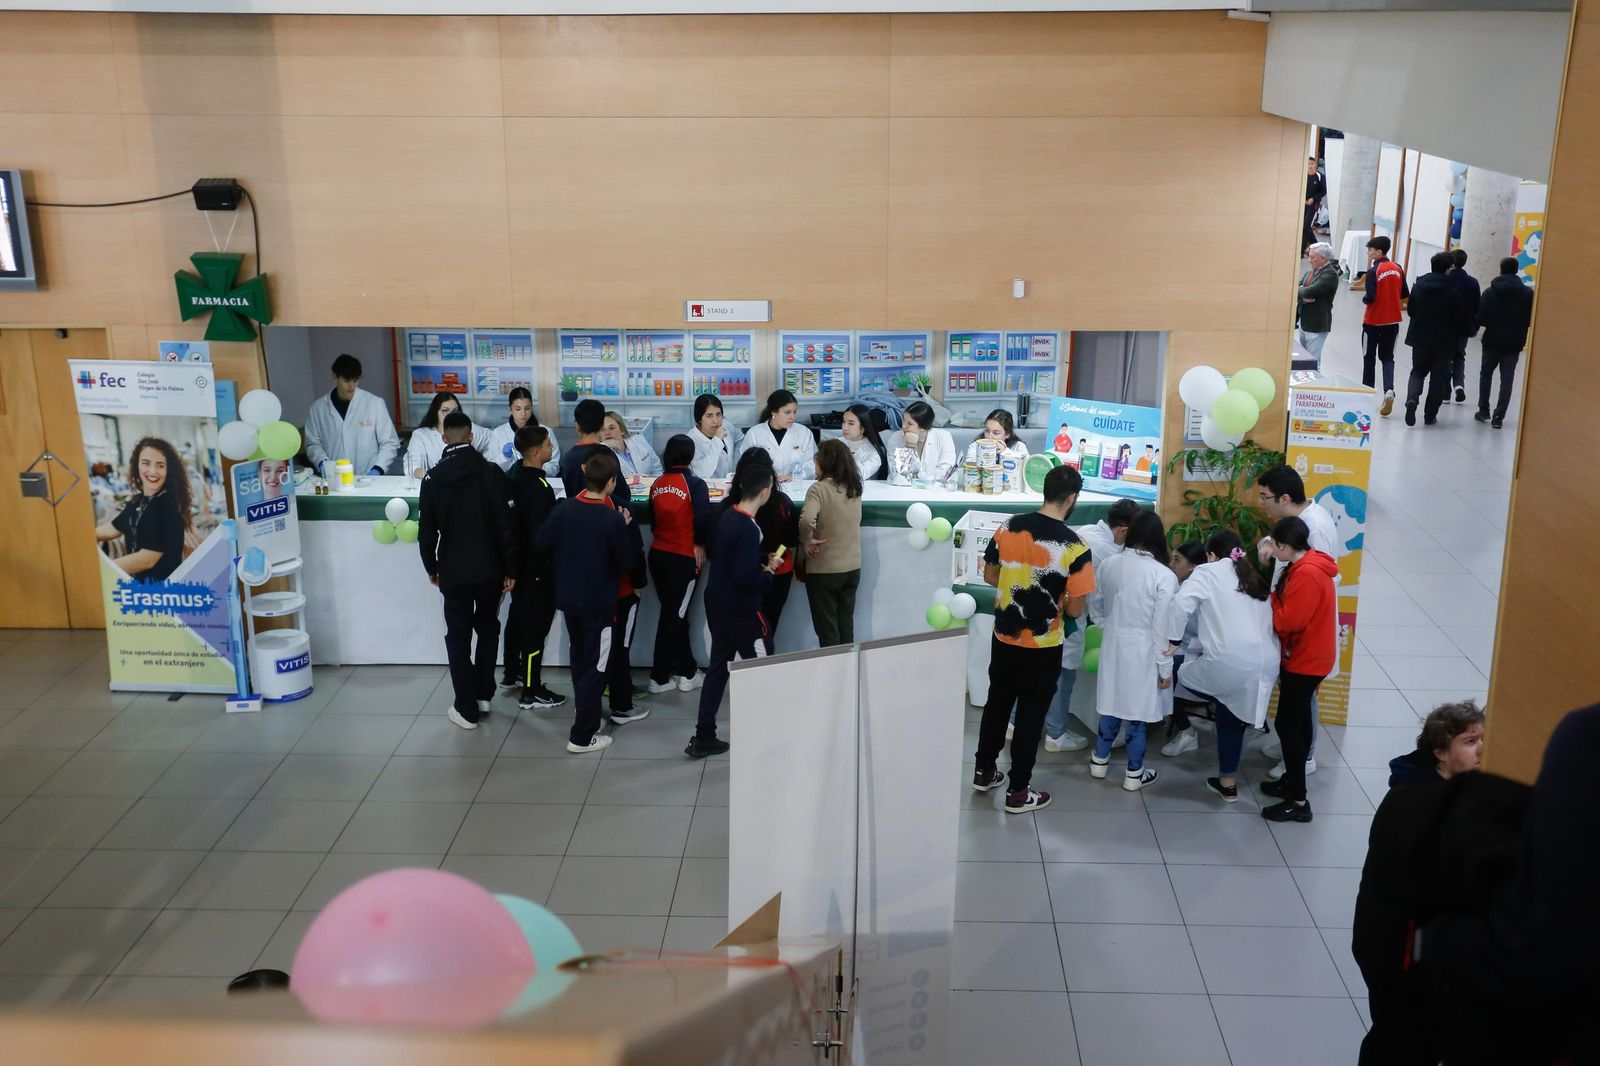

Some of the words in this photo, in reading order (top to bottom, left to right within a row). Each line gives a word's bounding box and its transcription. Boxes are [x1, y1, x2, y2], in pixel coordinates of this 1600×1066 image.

[191, 296, 249, 306] FARMACIA
[99, 372, 127, 388] fec
[139, 385, 155, 393] Virgen
[1296, 393, 1322, 402] FARMACIA
[1295, 400, 1336, 409] PARAFARMACIA
[1093, 416, 1136, 432] CUÍDATE
[250, 501, 287, 517] VITIS
[121, 589, 214, 607] Erasmus+
[113, 620, 157, 628] Enriqueciendo
[134, 650, 172, 658] oportunidad
[164, 659, 205, 668] extranjero
[279, 655, 310, 670] VITIS
